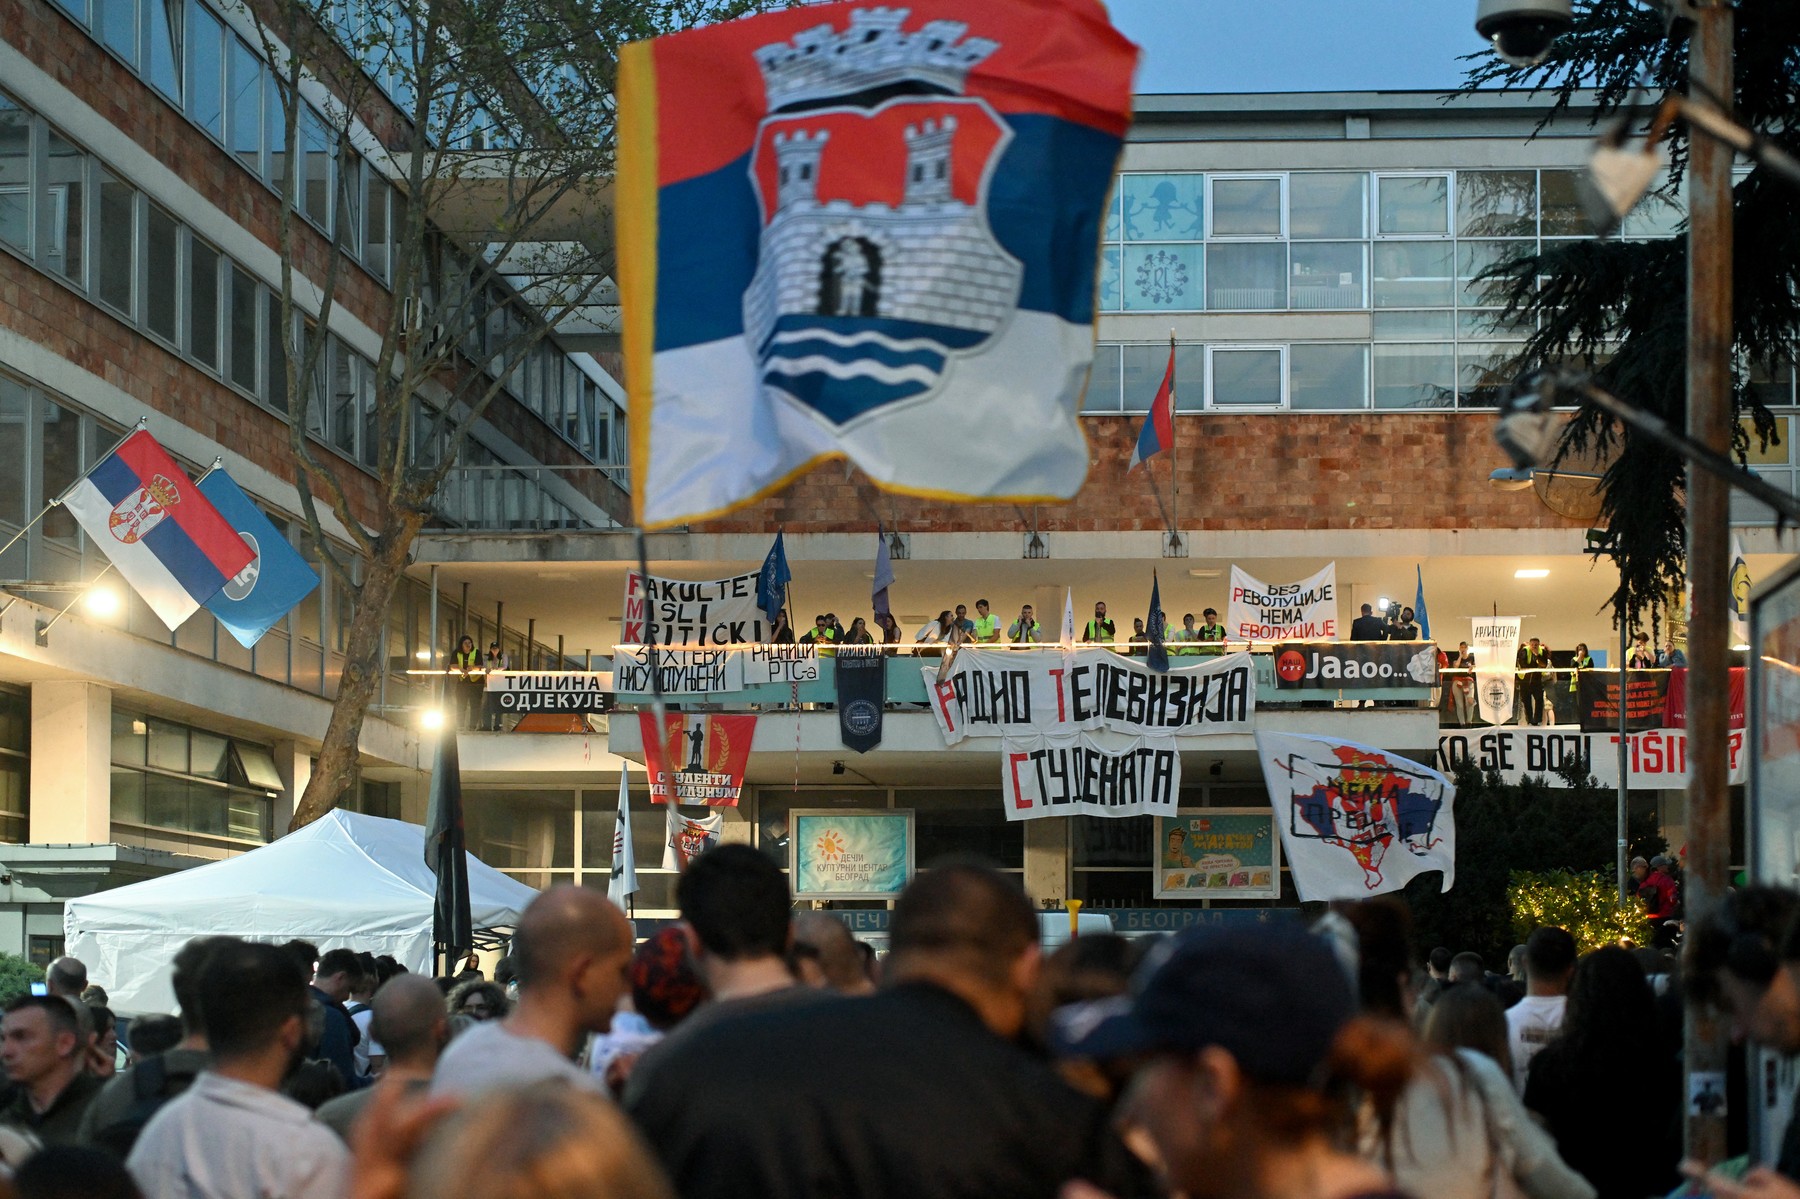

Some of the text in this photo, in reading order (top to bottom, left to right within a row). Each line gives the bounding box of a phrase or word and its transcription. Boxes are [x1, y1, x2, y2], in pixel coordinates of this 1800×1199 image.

[1233, 584, 1333, 608] РЕВОЛУЦИЈЕ
[626, 598, 708, 624] MISLI
[1260, 608, 1303, 624] НЕМА
[624, 621, 762, 646] KRITIČKI
[1240, 620, 1336, 640] ЕВОЛУЦИЈЕ
[752, 644, 815, 662] РАДНИЦИ
[769, 660, 817, 682] РТС-а
[505, 675, 600, 691] ТИШИНА
[500, 693, 604, 711] ОДЈЕКУЈЕ
[934, 670, 1031, 732] РАДИО
[1049, 662, 1249, 727] ТЕЛЕВИЗИЈА
[1480, 733, 1514, 772] SE
[1527, 735, 1591, 773] BOJI
[656, 771, 732, 786] СУДЕНТИ
[1009, 748, 1174, 809] СТУДЕНАТА
[841, 854, 864, 863] ДЕЧЈИ
[817, 864, 856, 872] КУЛТУРНИ
[836, 873, 869, 882] БЕОГРАД
[842, 913, 890, 930] ДЕЧЈ
